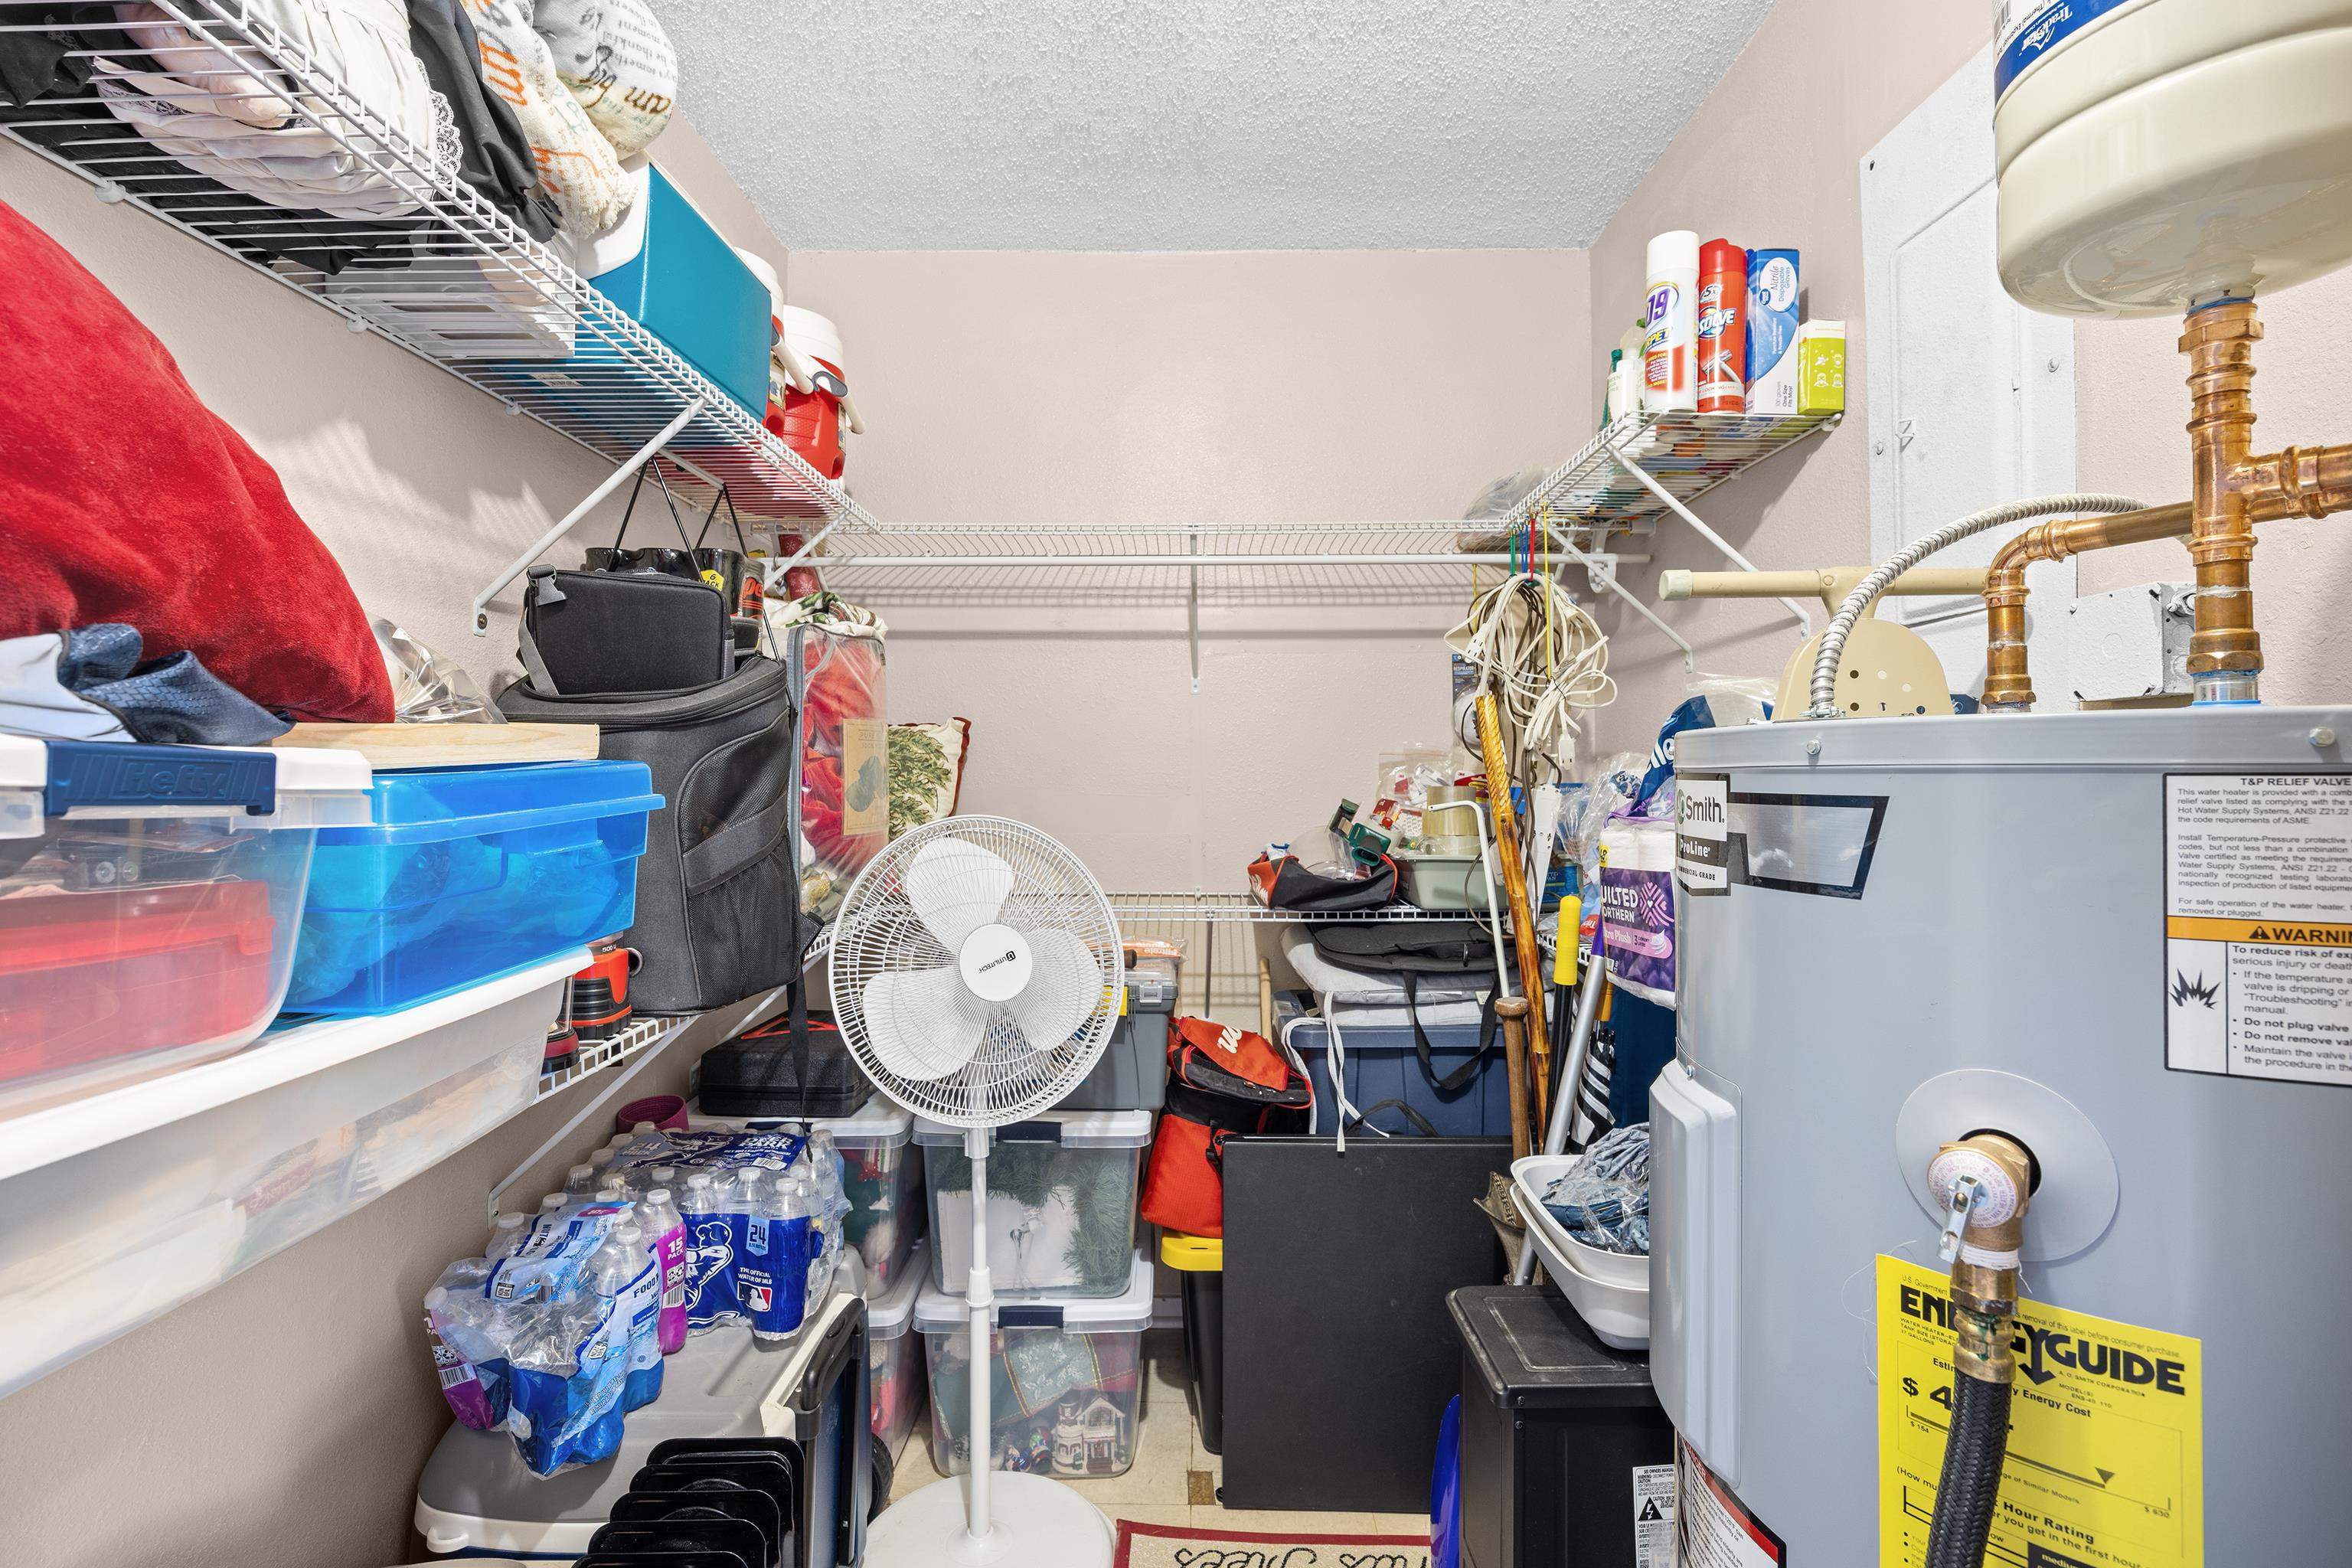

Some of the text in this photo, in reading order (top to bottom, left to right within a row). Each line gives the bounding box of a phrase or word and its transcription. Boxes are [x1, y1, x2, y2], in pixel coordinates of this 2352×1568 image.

[1770, 266, 1779, 290] Nitrile
[118, 762, 227, 800] Hefty
[2313, 778, 2351, 786] VALVE
[1686, 795, 1721, 823] Smith
[2265, 799, 2308, 807] complying
[2207, 835, 2300, 844] Temperature-Pressure
[1680, 838, 1709, 857] ProLine
[2255, 854, 2288, 862] meeting
[2207, 862, 2235, 871] Supply
[1700, 871, 1715, 880] GRADE
[2178, 871, 2309, 882] nationally recognized testing
[2178, 880, 2276, 890] inspection production
[1600, 885, 1638, 908] UILTED
[2217, 900, 2261, 908] operation
[1602, 908, 1635, 923] ORTHERN
[1614, 930, 1632, 944] Plush
[2233, 945, 2246, 954] To
[2250, 947, 2292, 956] reduce
[978, 956, 1008, 973] UTILITECH
[2233, 958, 2306, 969] serious injury
[2255, 972, 2344, 985] the temperature
[2244, 983, 2334, 997] valve dripping
[2244, 1018, 2261, 1027] Do
[2287, 1021, 2314, 1031] plug
[2318, 1024, 2349, 1033] valve
[2244, 1031, 2332, 1046] Do not remove
[2244, 1044, 2346, 1060] Maintain the valve
[2244, 1056, 2322, 1071] the procedure
[750, 1225, 766, 1245] 24
[668, 1236, 683, 1253] 15
[668, 1250, 684, 1260] PACK
[1915, 1279, 1948, 1296] Government
[423, 1317, 433, 1328] 1
[1900, 1317, 1919, 1329] WATER
[1908, 1331, 1935, 1346] GALLONS
[1917, 1329, 1929, 1338] SIZE
[2022, 1313, 2145, 1350] removal of this label before consumer
[1903, 1377, 1919, 1396] $
[2023, 1389, 2062, 1410] Energy
[2066, 1403, 2091, 1417] Cost
[1917, 1425, 1929, 1433] 154
[1896, 1466, 1920, 1482] (How
[2023, 1479, 2050, 1493] Similar
[2004, 1501, 2095, 1544] Hour Rating
[2004, 1515, 2024, 1530] you
[2027, 1525, 2047, 1538] get
[2049, 1530, 2059, 1542] in
[2063, 1536, 2082, 1550] the
[2085, 1544, 2109, 1560] first
